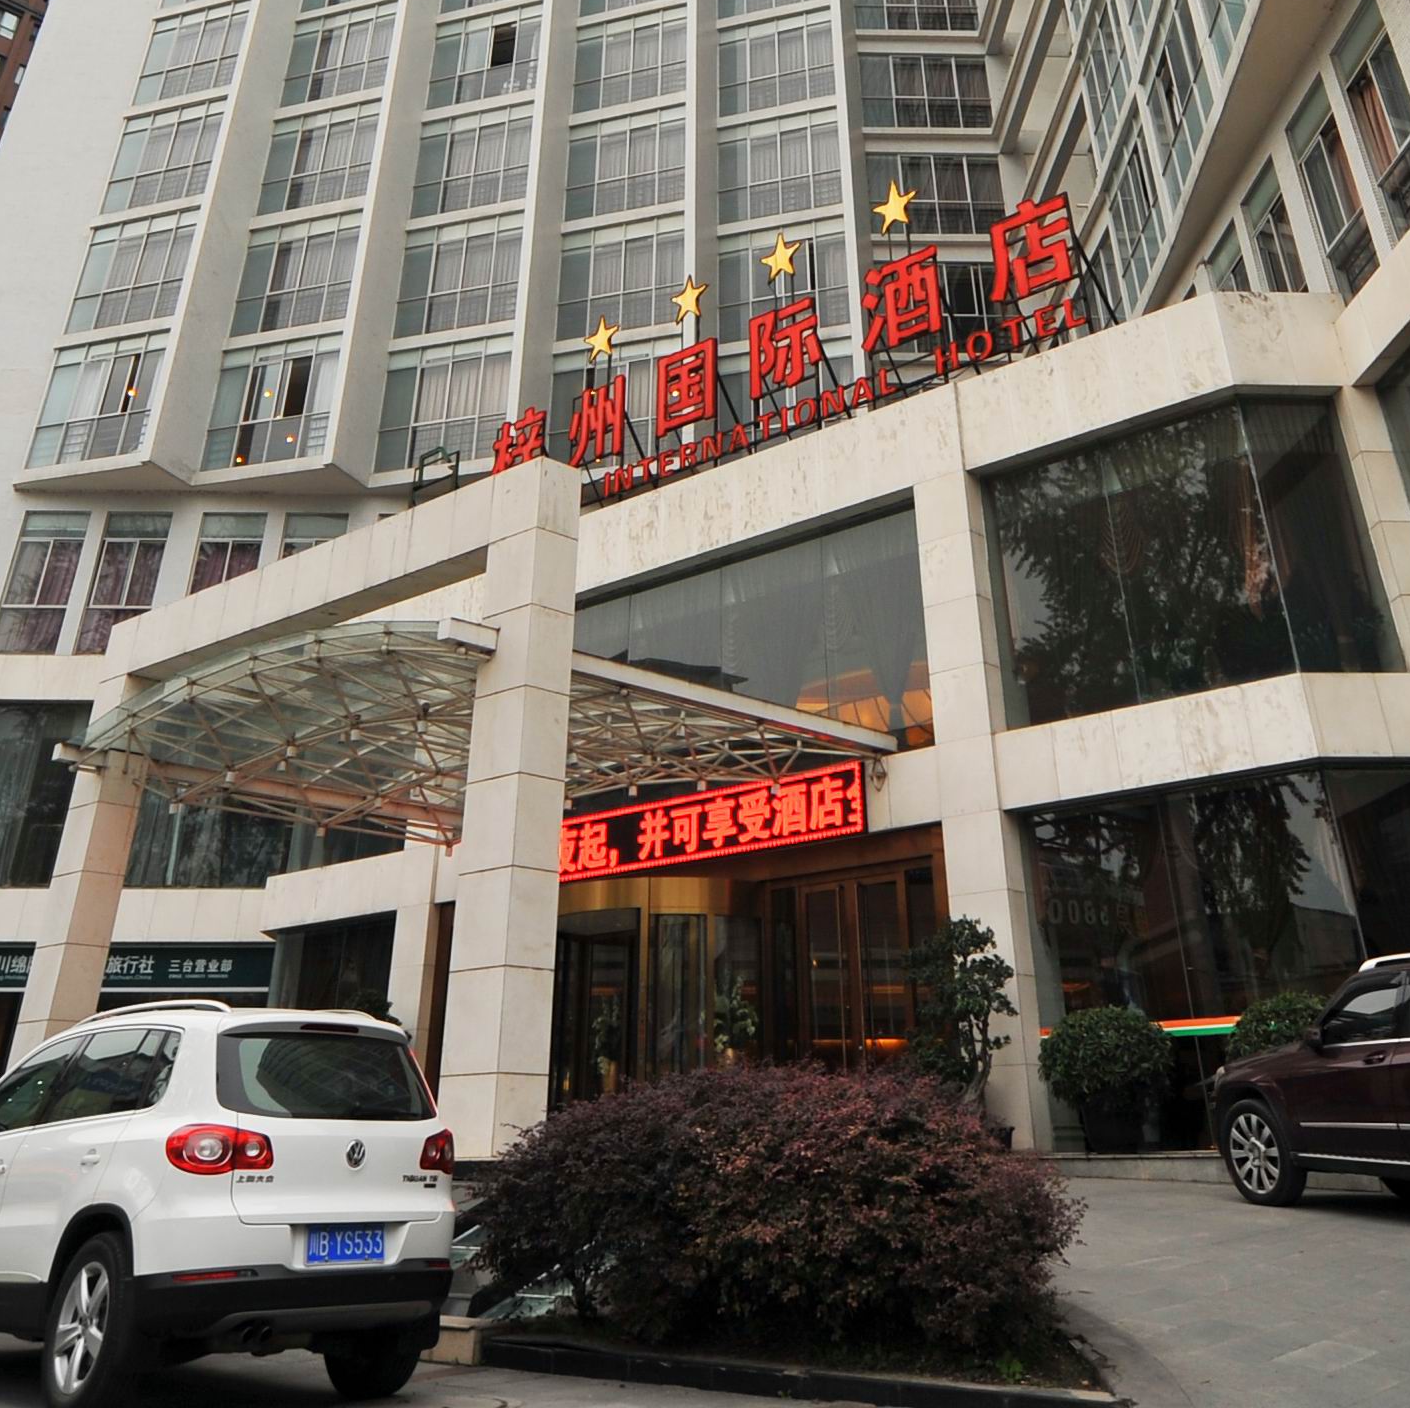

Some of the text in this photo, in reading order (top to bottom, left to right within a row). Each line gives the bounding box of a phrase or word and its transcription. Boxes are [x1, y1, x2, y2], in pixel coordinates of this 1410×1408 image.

[492, 192, 1076, 475] 梓州国际酒店
[603, 298, 1087, 497] INTERNATIONAL HOTEL
[106, 955, 155, 974] 旅行社
[168, 958, 233, 973] 三台营业部
[309, 1230, 383, 1257] 川B·YS533
